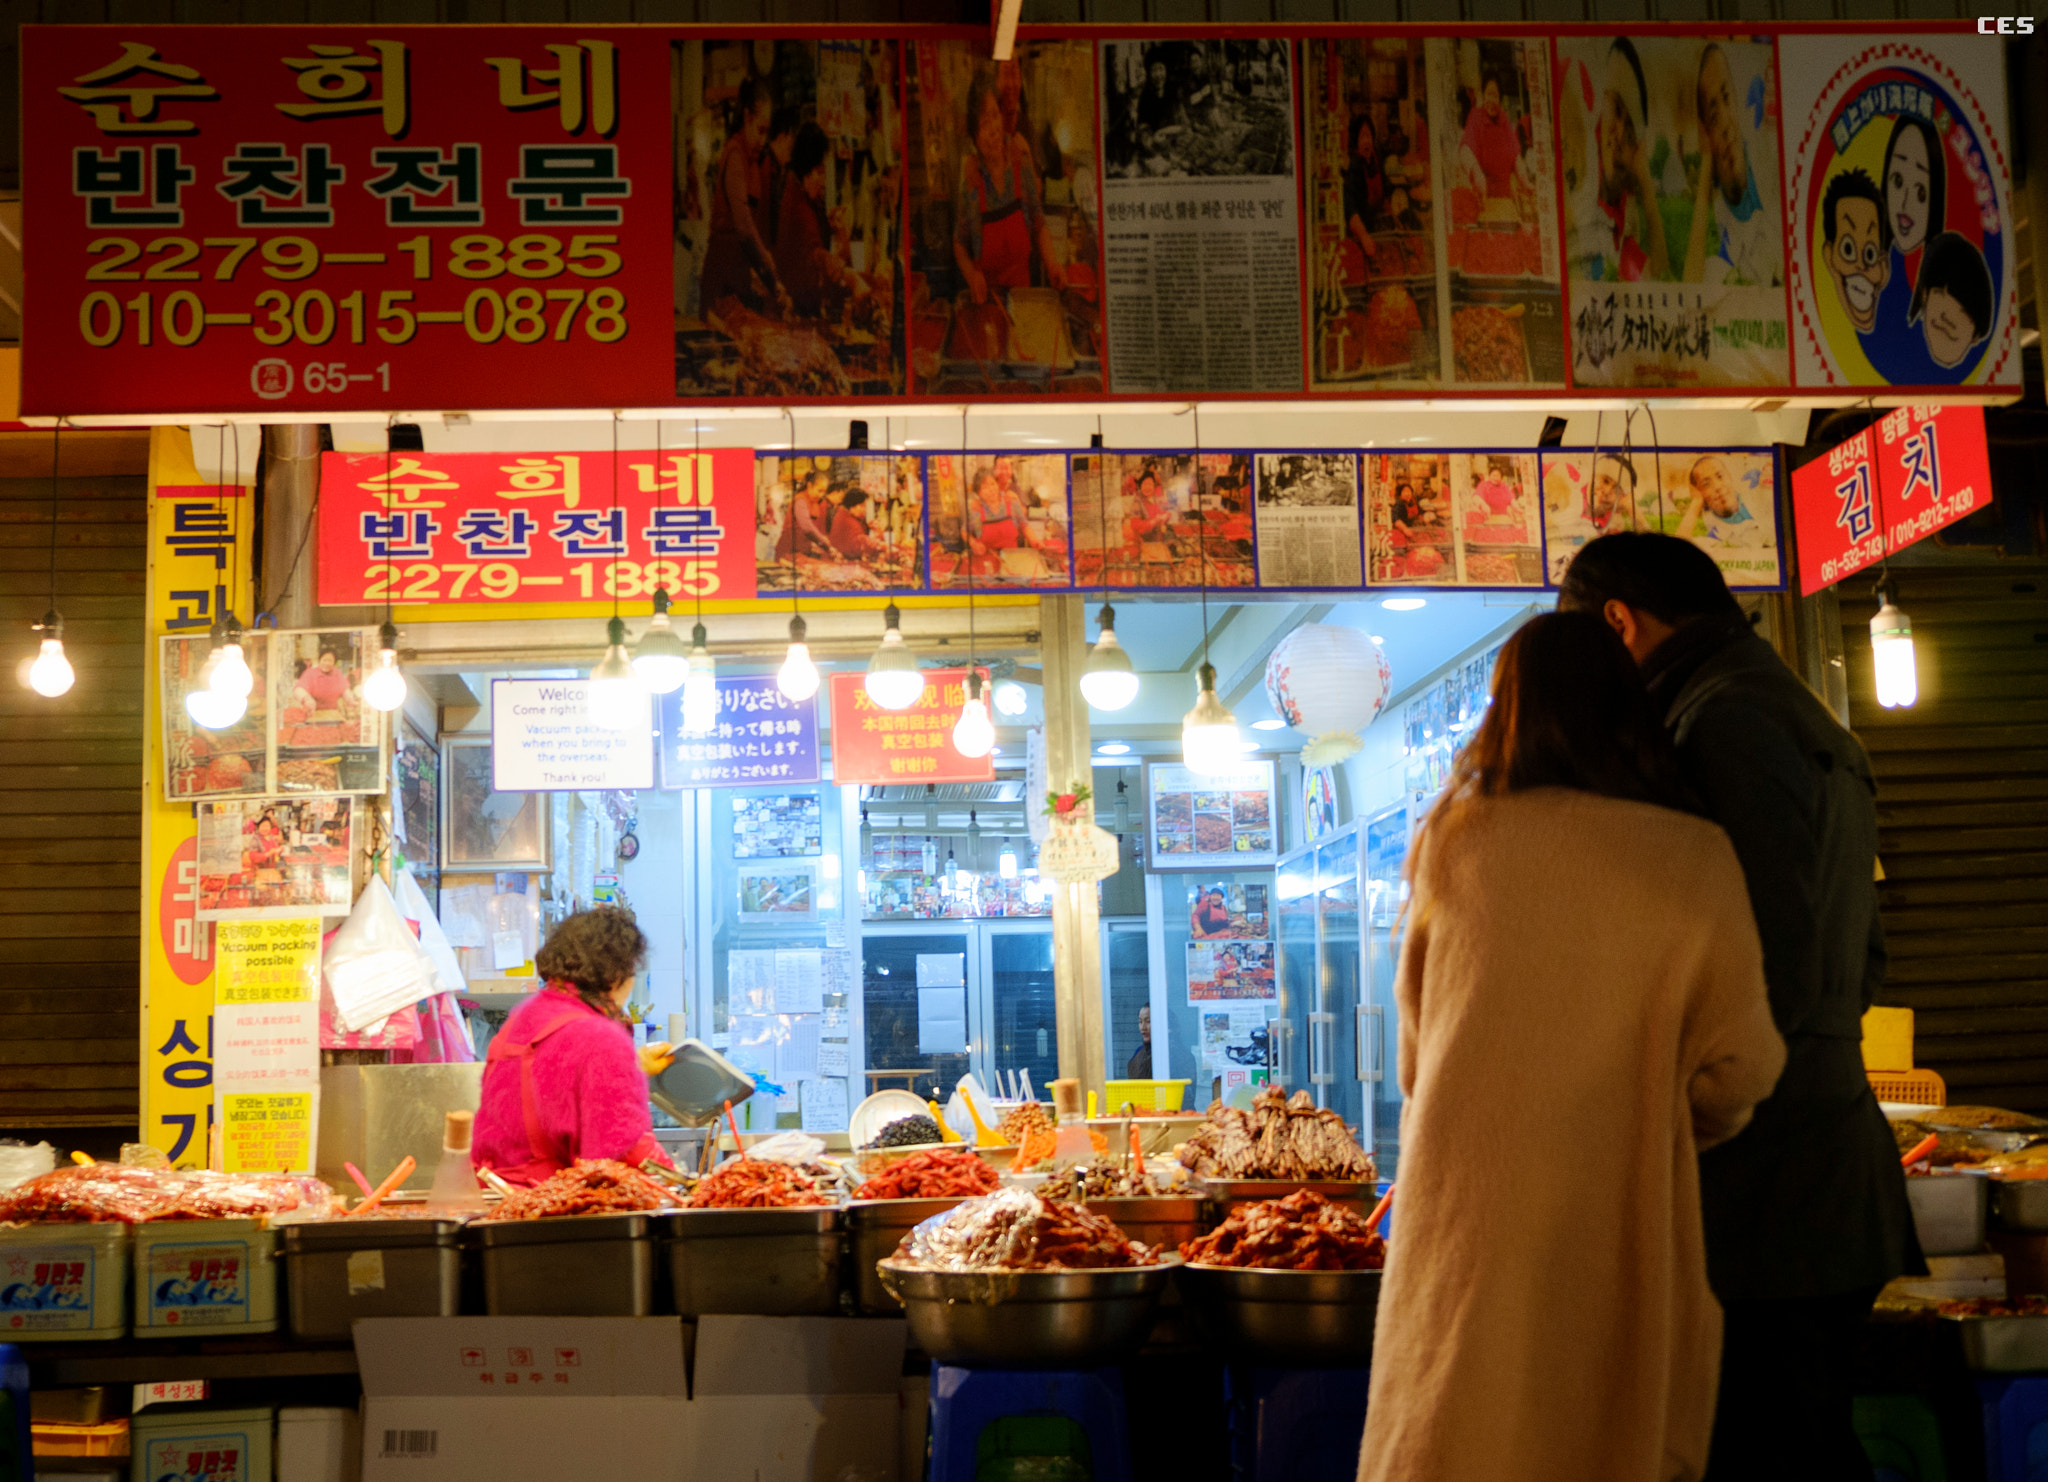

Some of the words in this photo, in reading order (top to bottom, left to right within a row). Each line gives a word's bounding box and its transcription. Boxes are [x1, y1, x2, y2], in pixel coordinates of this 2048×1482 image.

[57, 39, 618, 137] 순희네
[72, 143, 631, 228] 반찬전문
[86, 235, 623, 281] 2279-1885
[80, 288, 628, 346] 010-3015-0878
[303, 361, 390, 393] 65-1
[357, 453, 714, 509] 순희네
[360, 507, 725, 560] 반찬전문
[362, 561, 721, 600] 2279-1885
[538, 687, 588, 702] Welco
[512, 704, 546, 715] Come
[549, 704, 577, 716] right
[525, 723, 571, 734] Vacuum
[521, 737, 554, 748] when
[557, 740, 578, 749] you
[582, 737, 611, 749] bring
[615, 738, 627, 748] to
[881, 732, 944, 750] 真空包装
[537, 753, 556, 762] the
[890, 756, 938, 774] 谢谢你
[543, 772, 577, 783] Thank
[581, 772, 606, 784] you!
[221, 942, 268, 953] Vacuum
[271, 940, 317, 952] packing
[246, 955, 294, 967] possible
